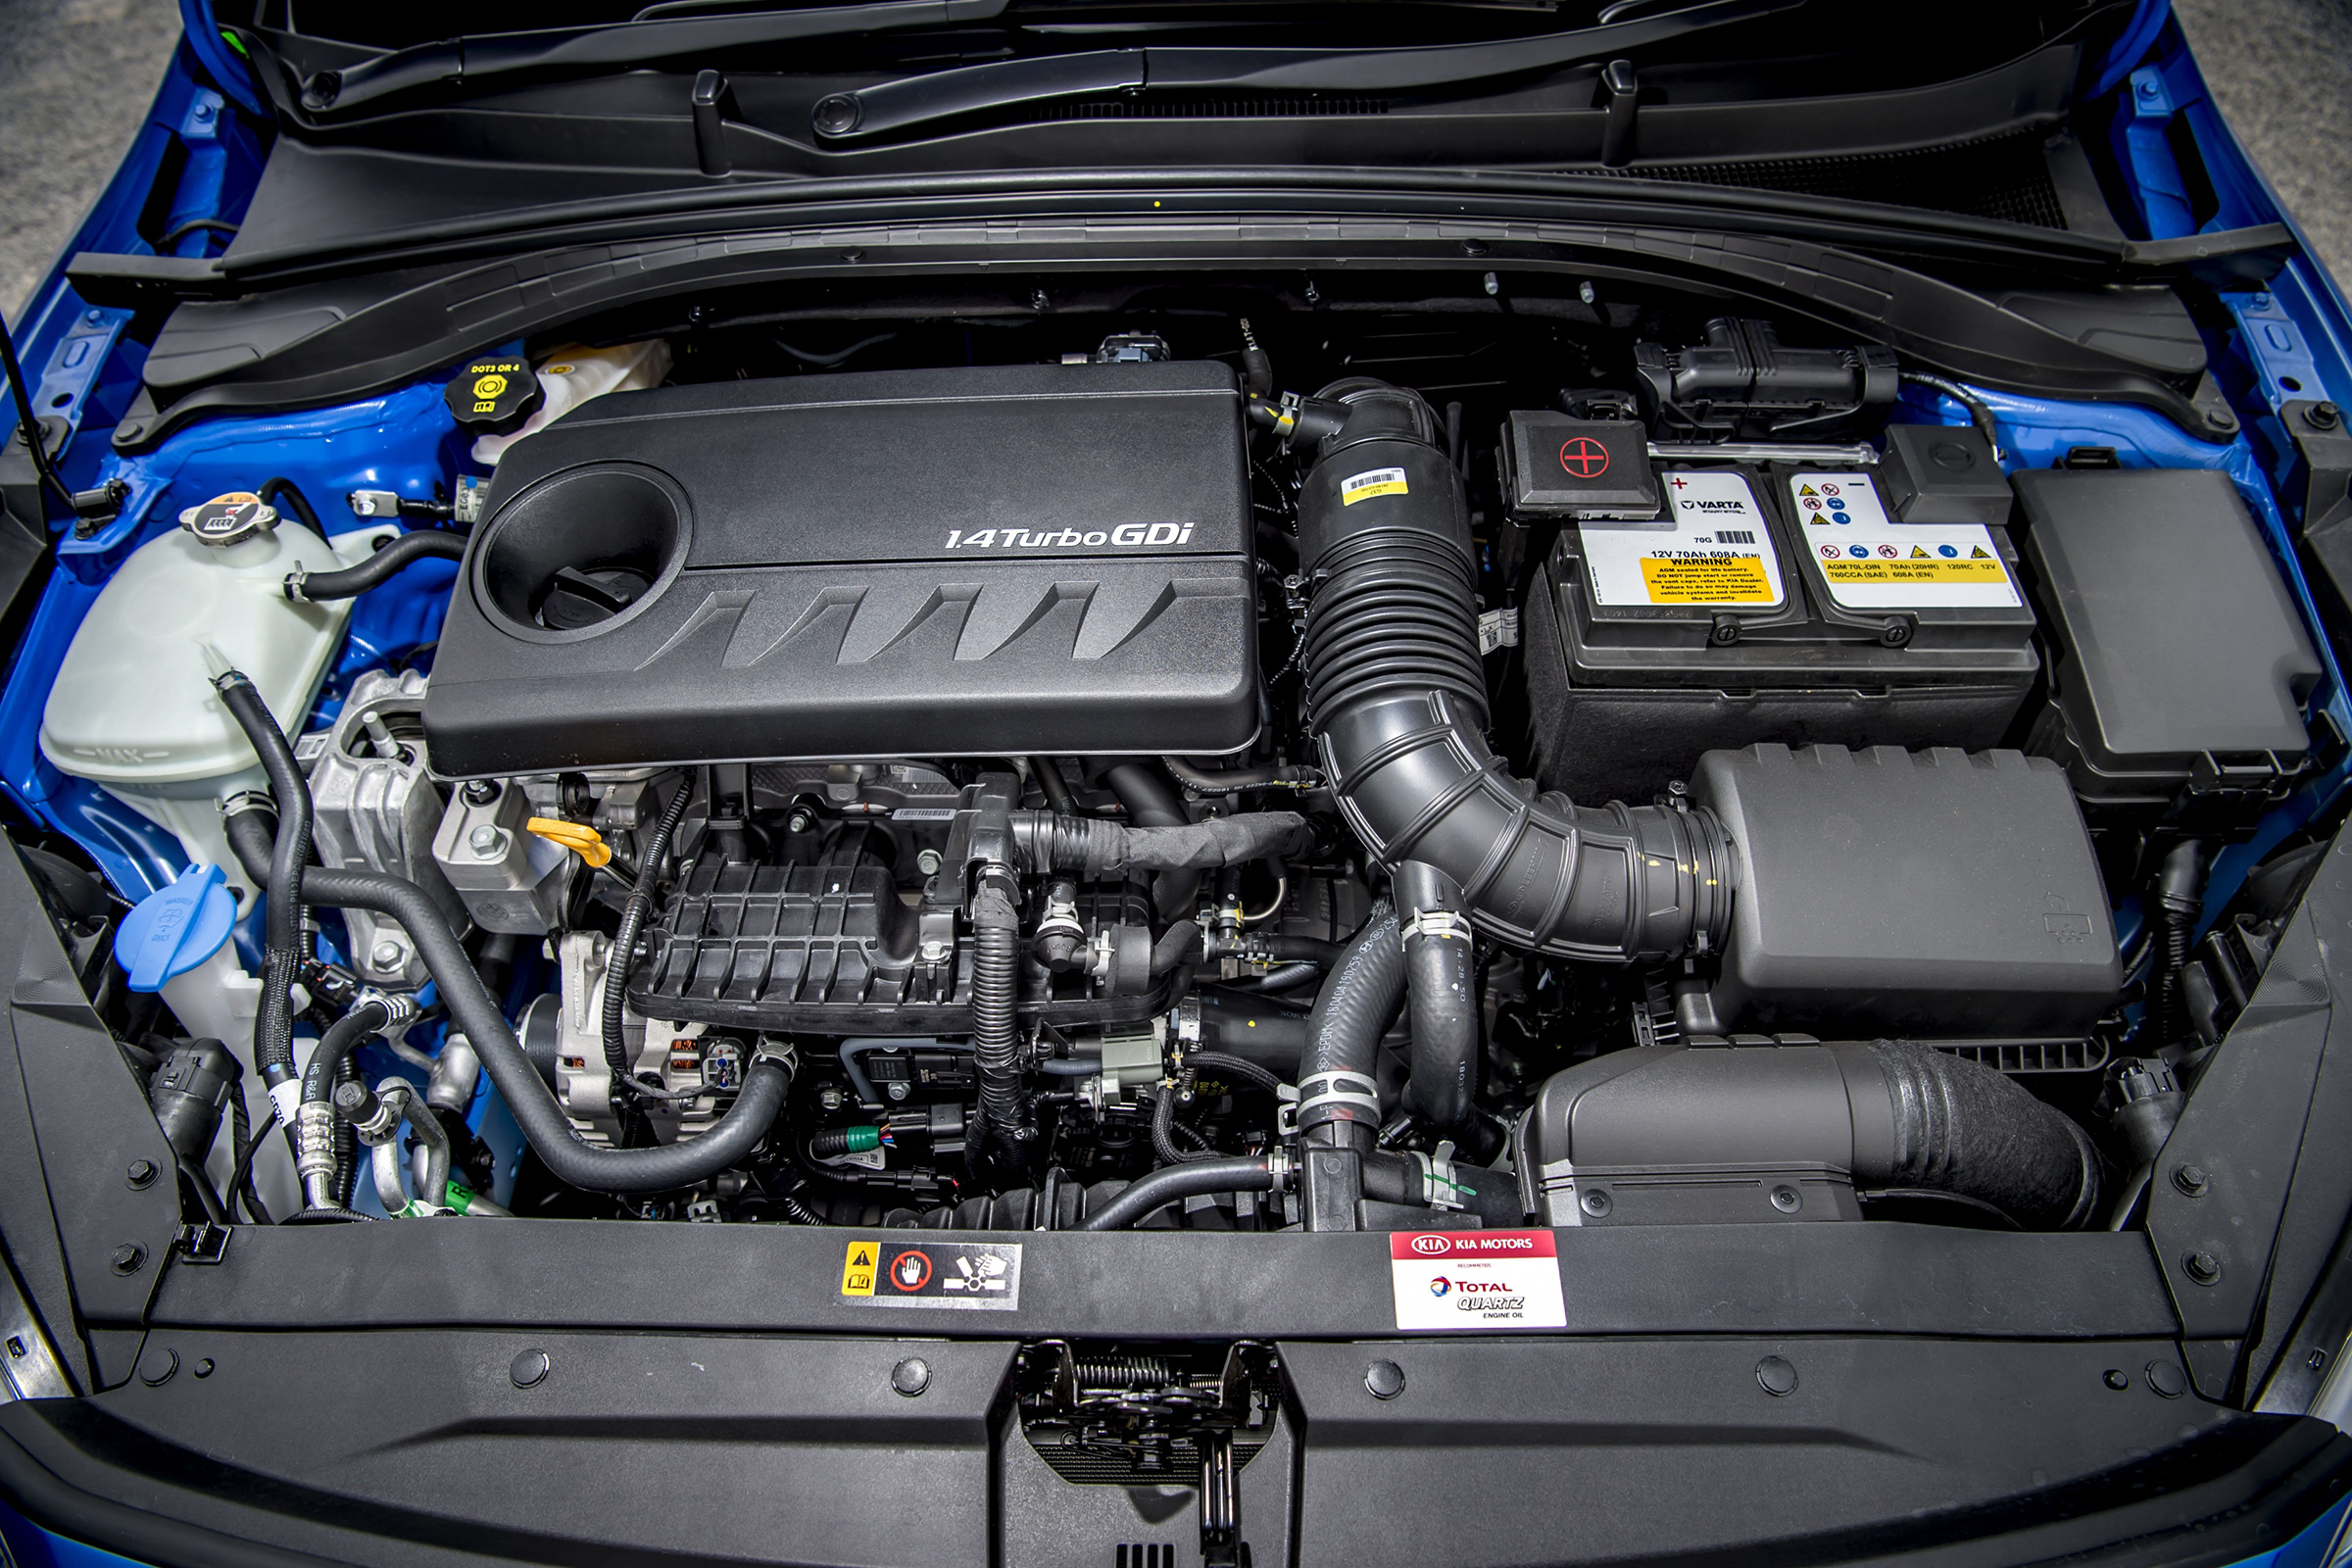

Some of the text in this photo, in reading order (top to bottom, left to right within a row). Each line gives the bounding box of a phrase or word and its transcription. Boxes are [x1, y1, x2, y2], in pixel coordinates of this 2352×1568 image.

[471, 365, 496, 373] DOT3
[945, 522, 1195, 548] 1.4 Turbo GDi
[96, 748, 143, 763] MAX
[533, 820, 580, 835] ENGINE
[309, 1063, 321, 1075] HS
[1418, 1239, 1445, 1250] KIA
[1456, 1238, 1533, 1249] KIA MOTORS
[1455, 1281, 1513, 1292] TOTAL
[1457, 1296, 1525, 1310] QUARTZ
